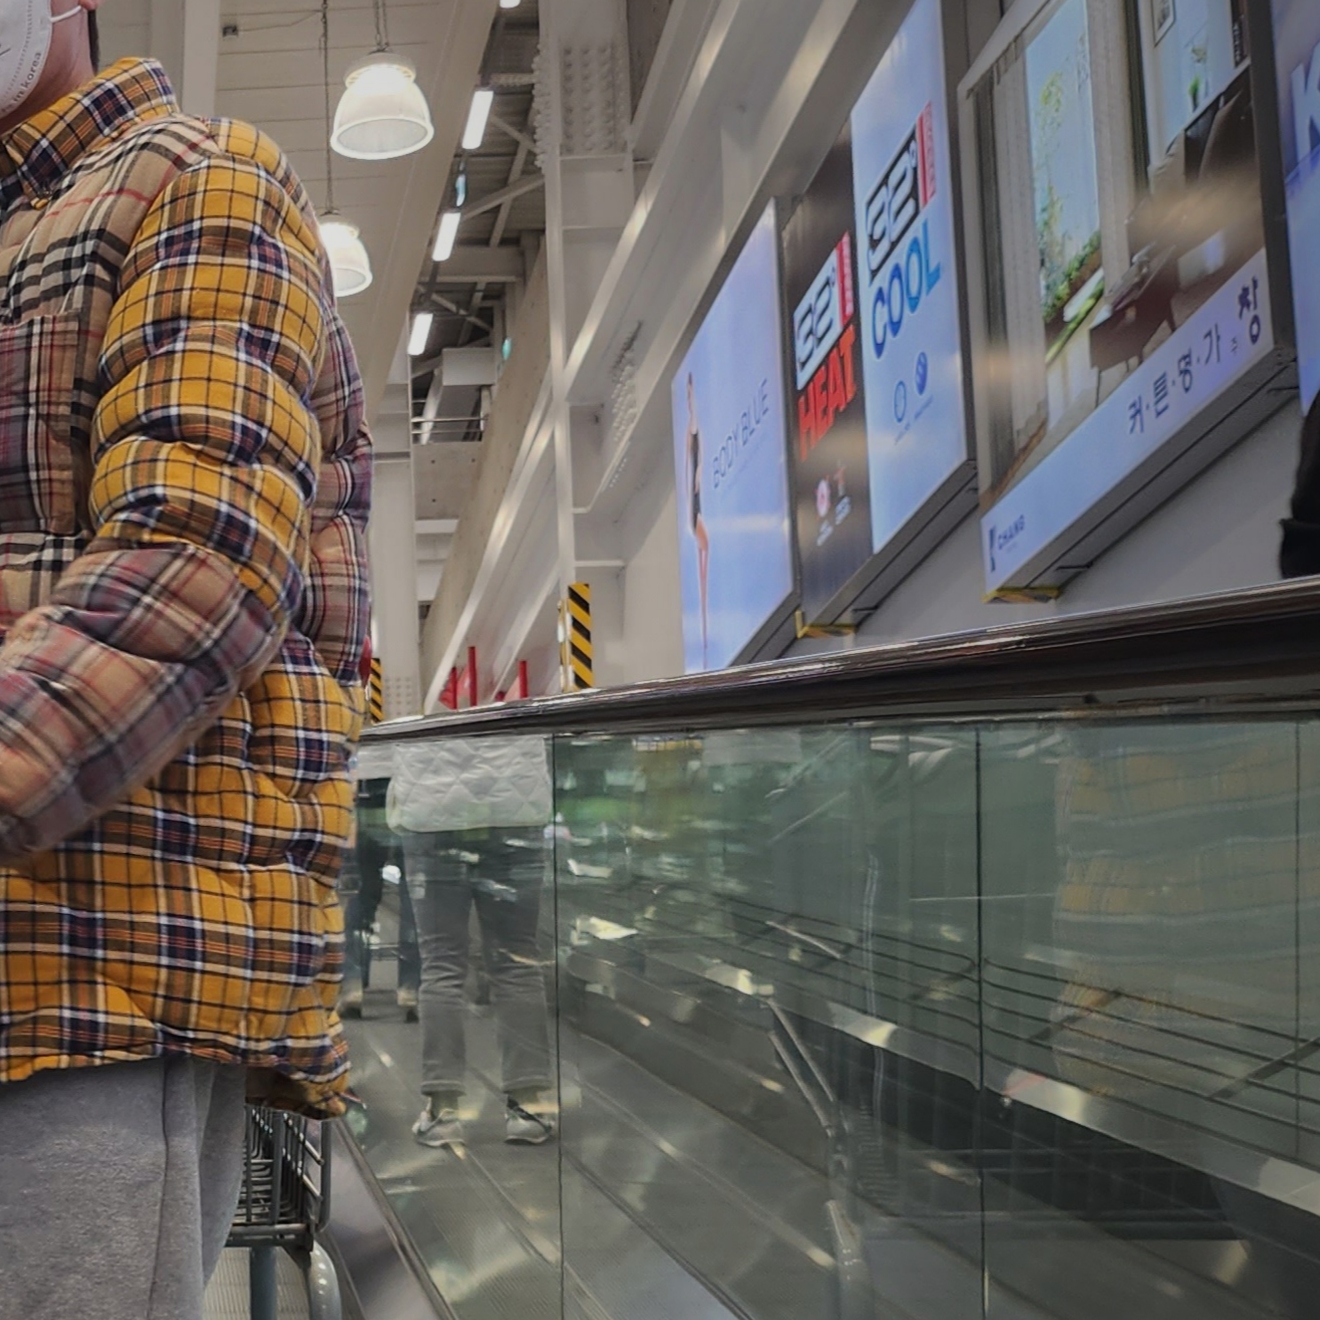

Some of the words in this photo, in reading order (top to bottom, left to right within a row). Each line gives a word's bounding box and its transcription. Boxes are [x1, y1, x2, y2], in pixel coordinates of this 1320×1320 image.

[20, 52, 42, 89] korea
[872, 218, 941, 359] COOL
[713, 423, 739, 489] BODY
[741, 378, 769, 446] BLUE
[798, 324, 856, 462] HEAT
